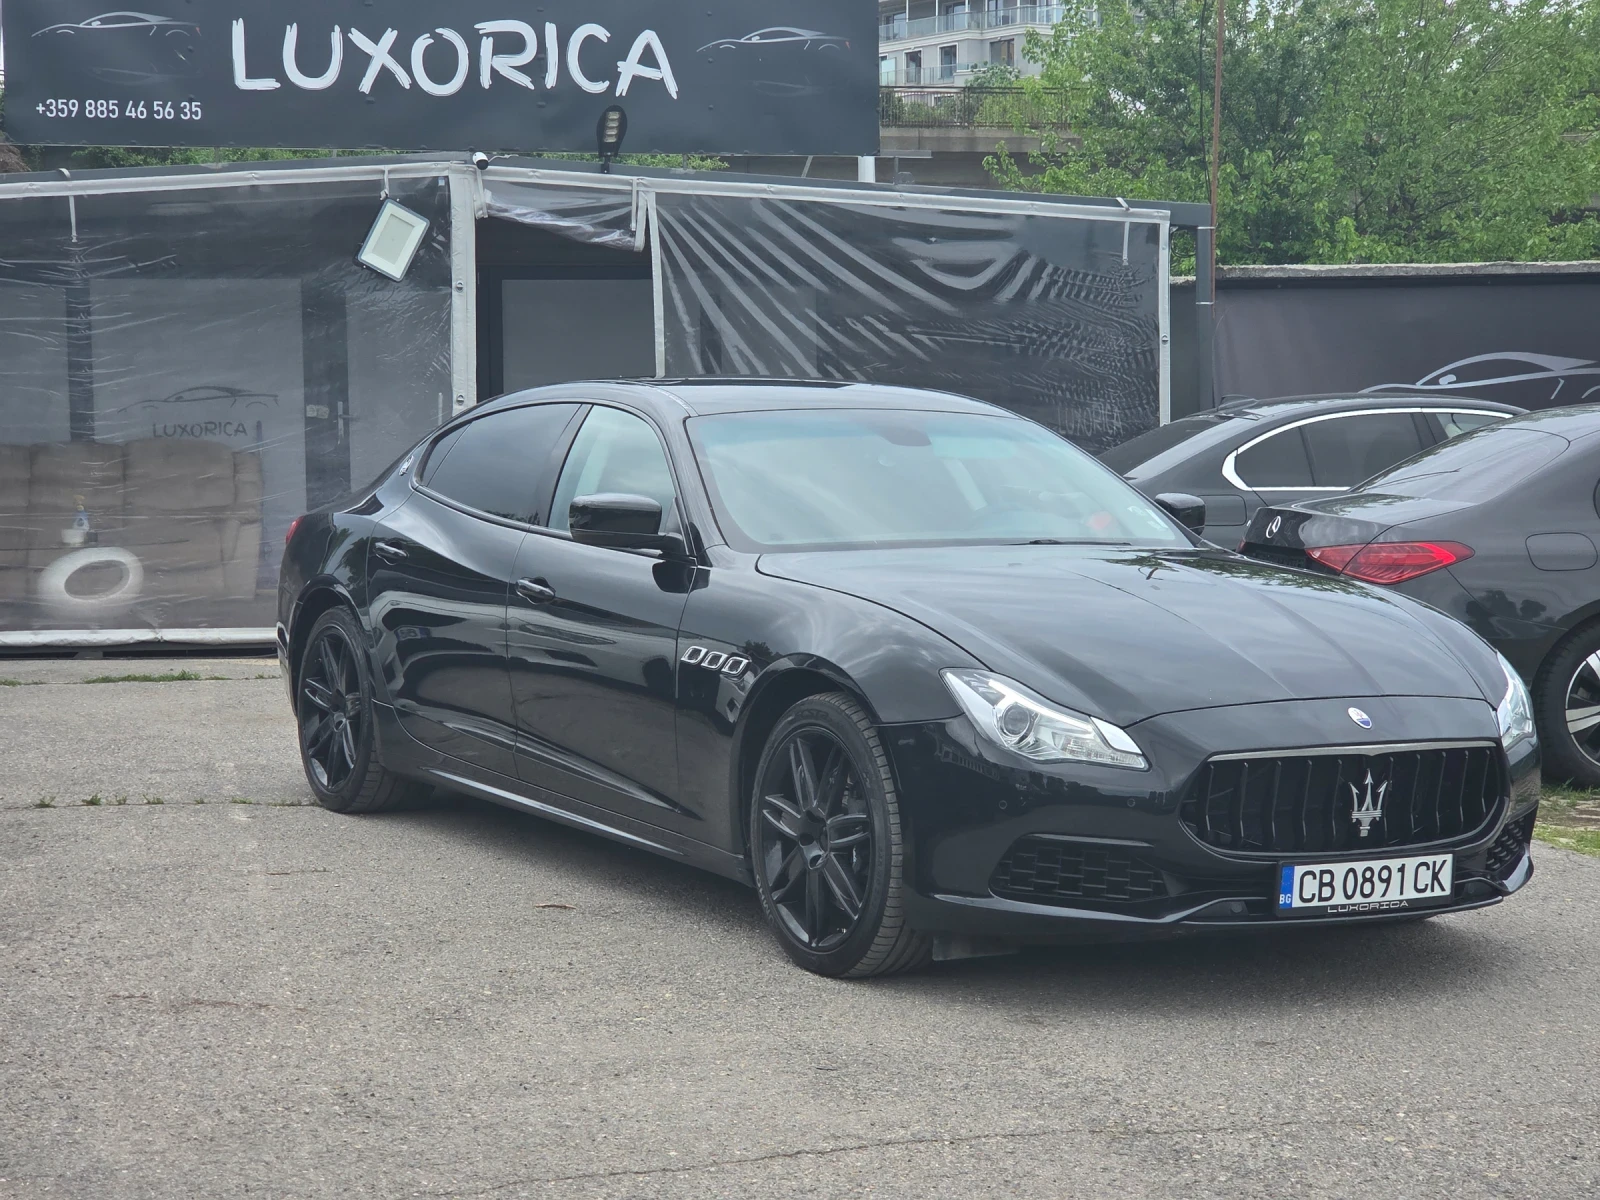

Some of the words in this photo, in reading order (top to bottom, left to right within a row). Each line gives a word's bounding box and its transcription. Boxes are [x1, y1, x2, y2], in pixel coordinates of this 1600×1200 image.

[231, 18, 678, 100] LUXORICA
[36, 99, 79, 118] +359
[85, 100, 118, 118] 885
[125, 101, 147, 119] 46
[153, 101, 174, 119] 56
[180, 101, 202, 120] 35
[152, 421, 248, 438] LUXORICA
[1299, 870, 1335, 903] CB
[1343, 864, 1406, 900] 0891
[1414, 860, 1447, 893] CK
[1279, 893, 1292, 904] BG
[1327, 901, 1408, 913] LUXORICA
